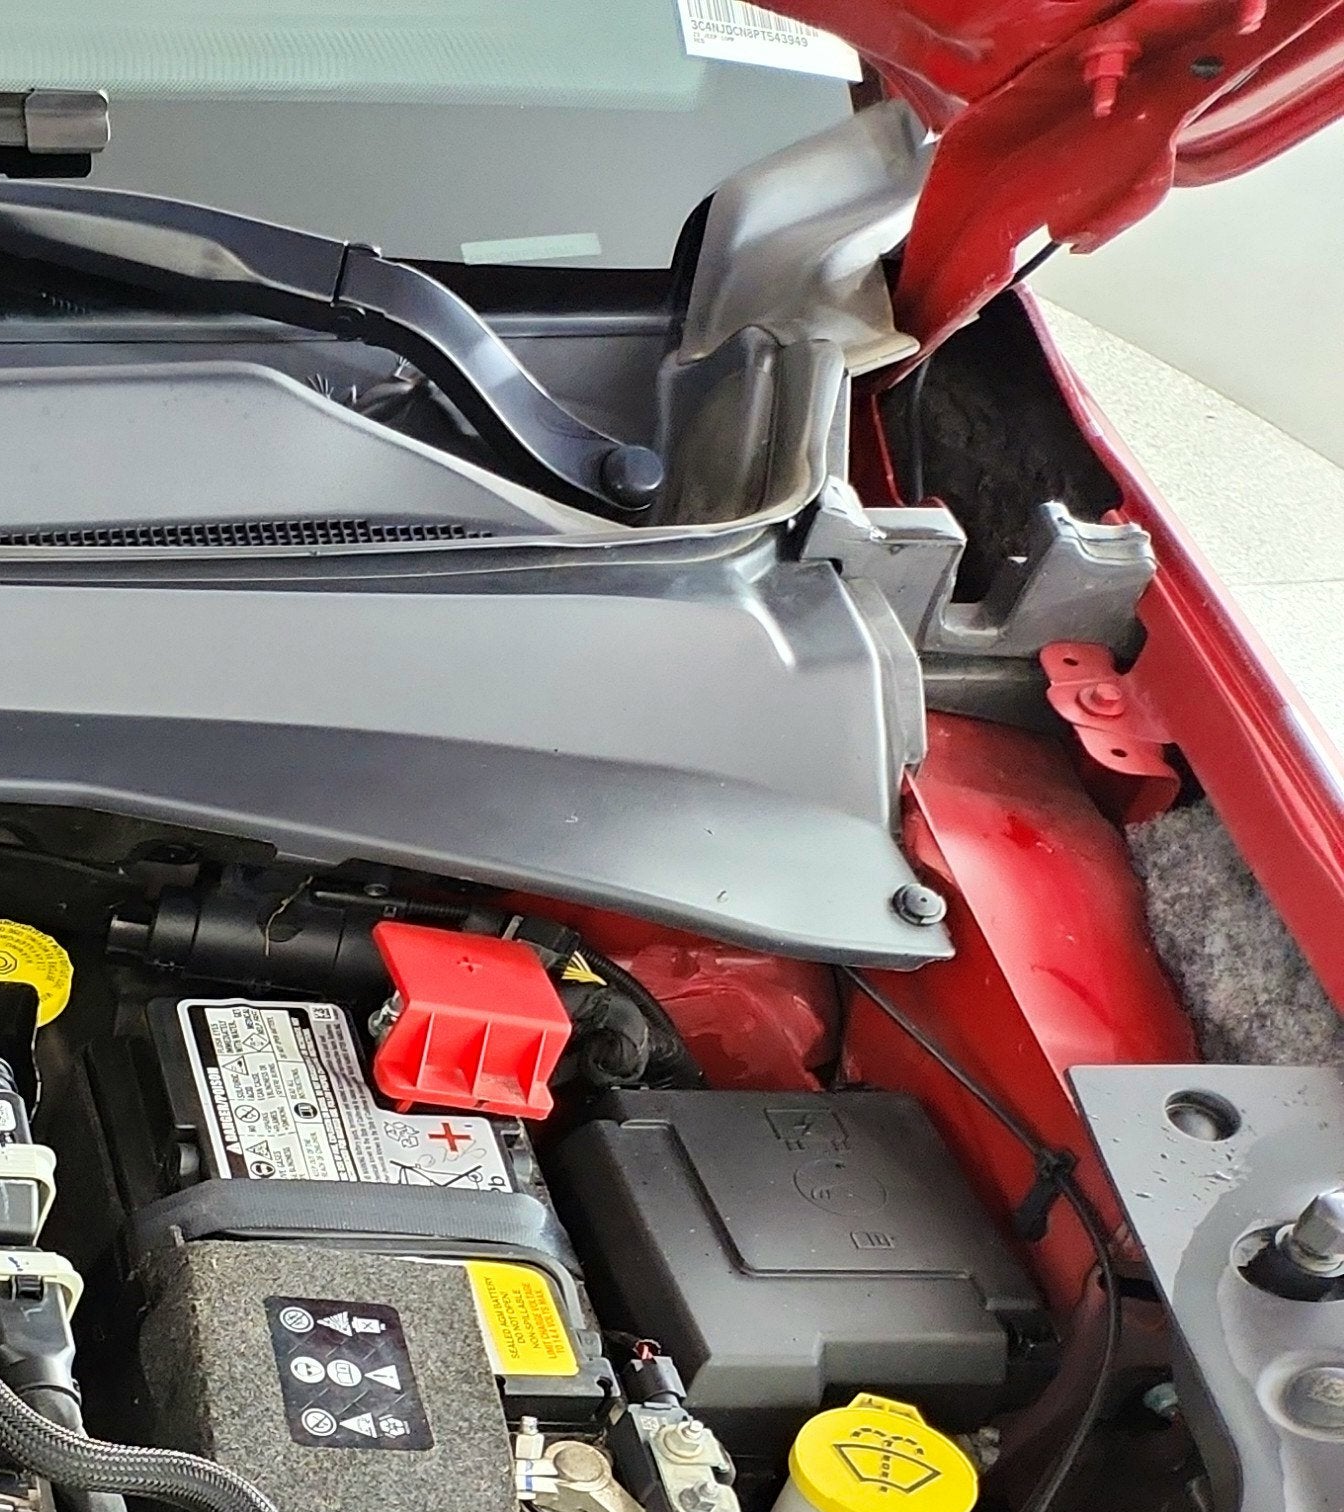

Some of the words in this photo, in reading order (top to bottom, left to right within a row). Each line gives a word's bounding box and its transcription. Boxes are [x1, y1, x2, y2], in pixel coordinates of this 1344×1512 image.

[206, 1066, 238, 1141] DANGER/POISON
[483, 1276, 501, 1308] BATTERY
[494, 1310, 508, 1326] AGM
[508, 1315, 521, 1330] NOT
[501, 1328, 519, 1358] SEALED
[514, 1332, 525, 1343] DO
[543, 1341, 557, 1358] LIMIT
